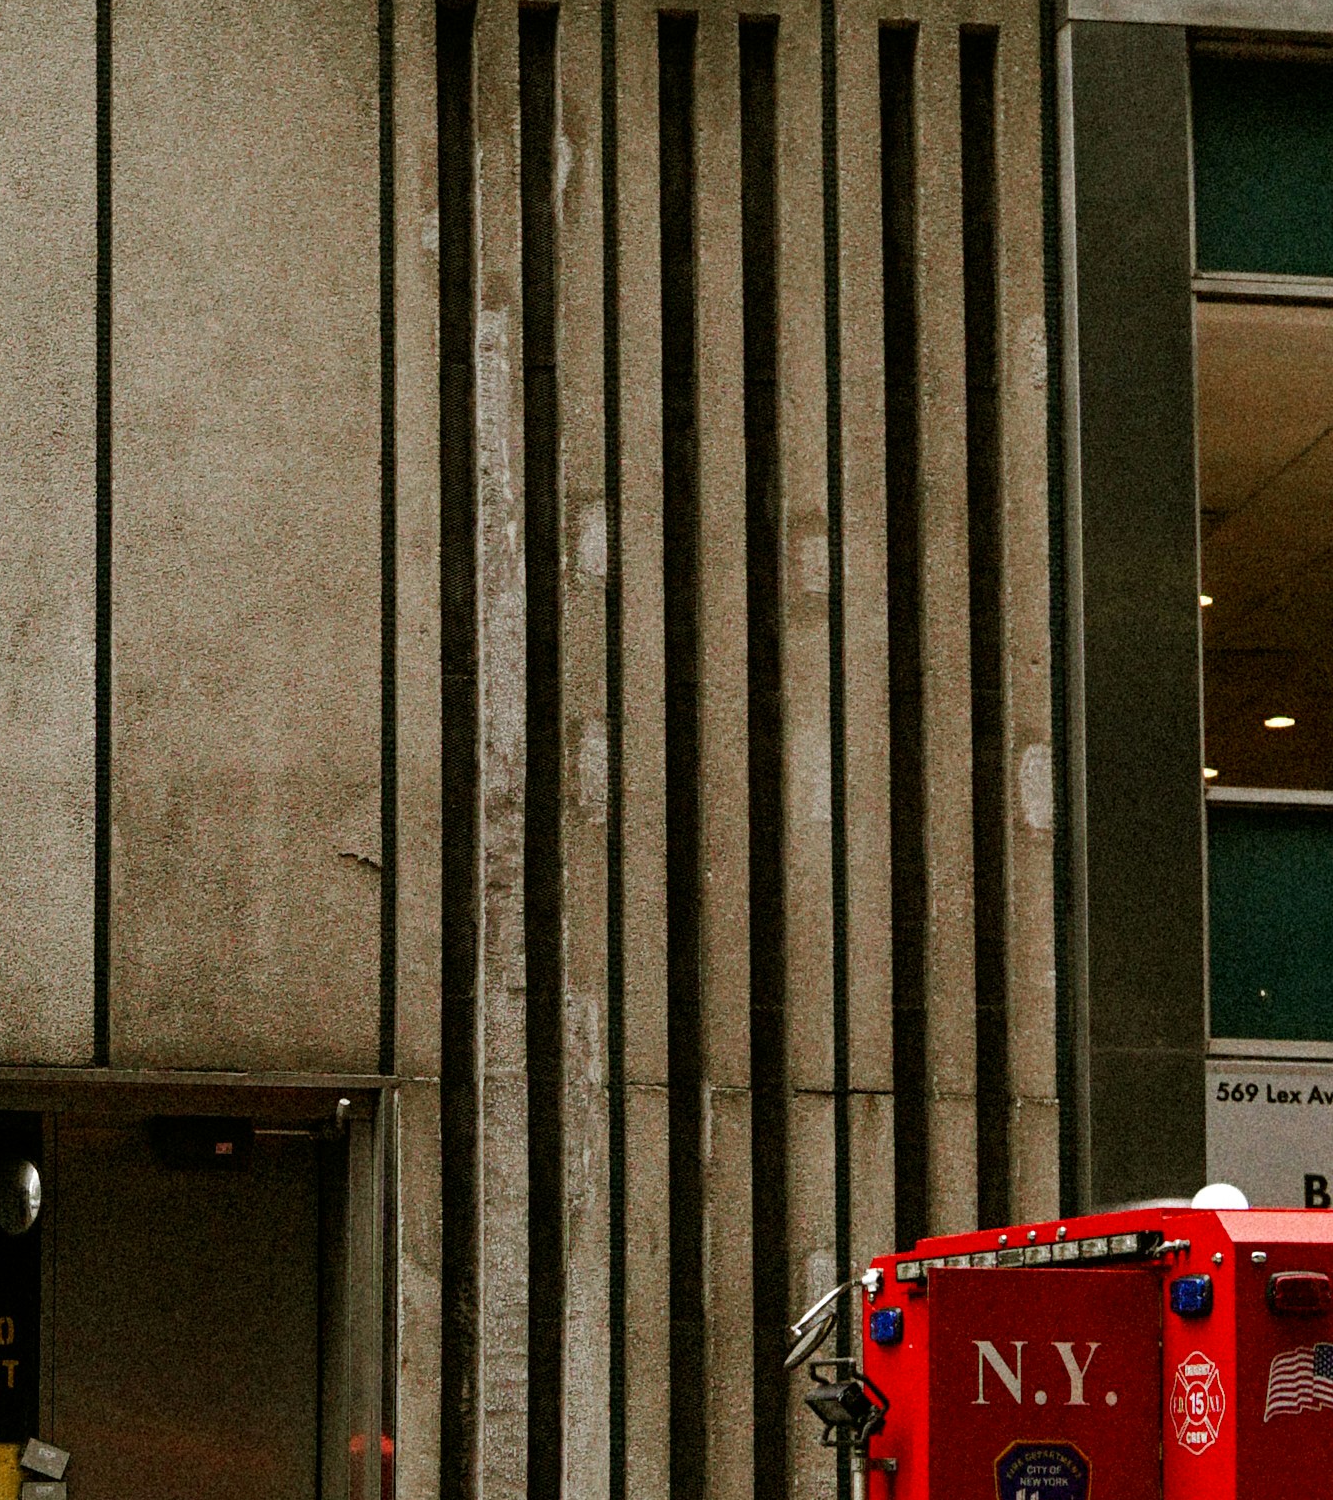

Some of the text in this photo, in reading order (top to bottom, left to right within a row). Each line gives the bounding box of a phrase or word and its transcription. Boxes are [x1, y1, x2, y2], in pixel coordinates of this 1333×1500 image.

[1216, 1082, 1259, 1102] 569
[1266, 1083, 1302, 1104] Lex
[971, 1340, 1118, 1406] N.Y.
[1189, 1391, 1205, 1415] 15
[1027, 1465, 1062, 1475] CITY OF
[1019, 1477, 1069, 1486] NEW YORK
